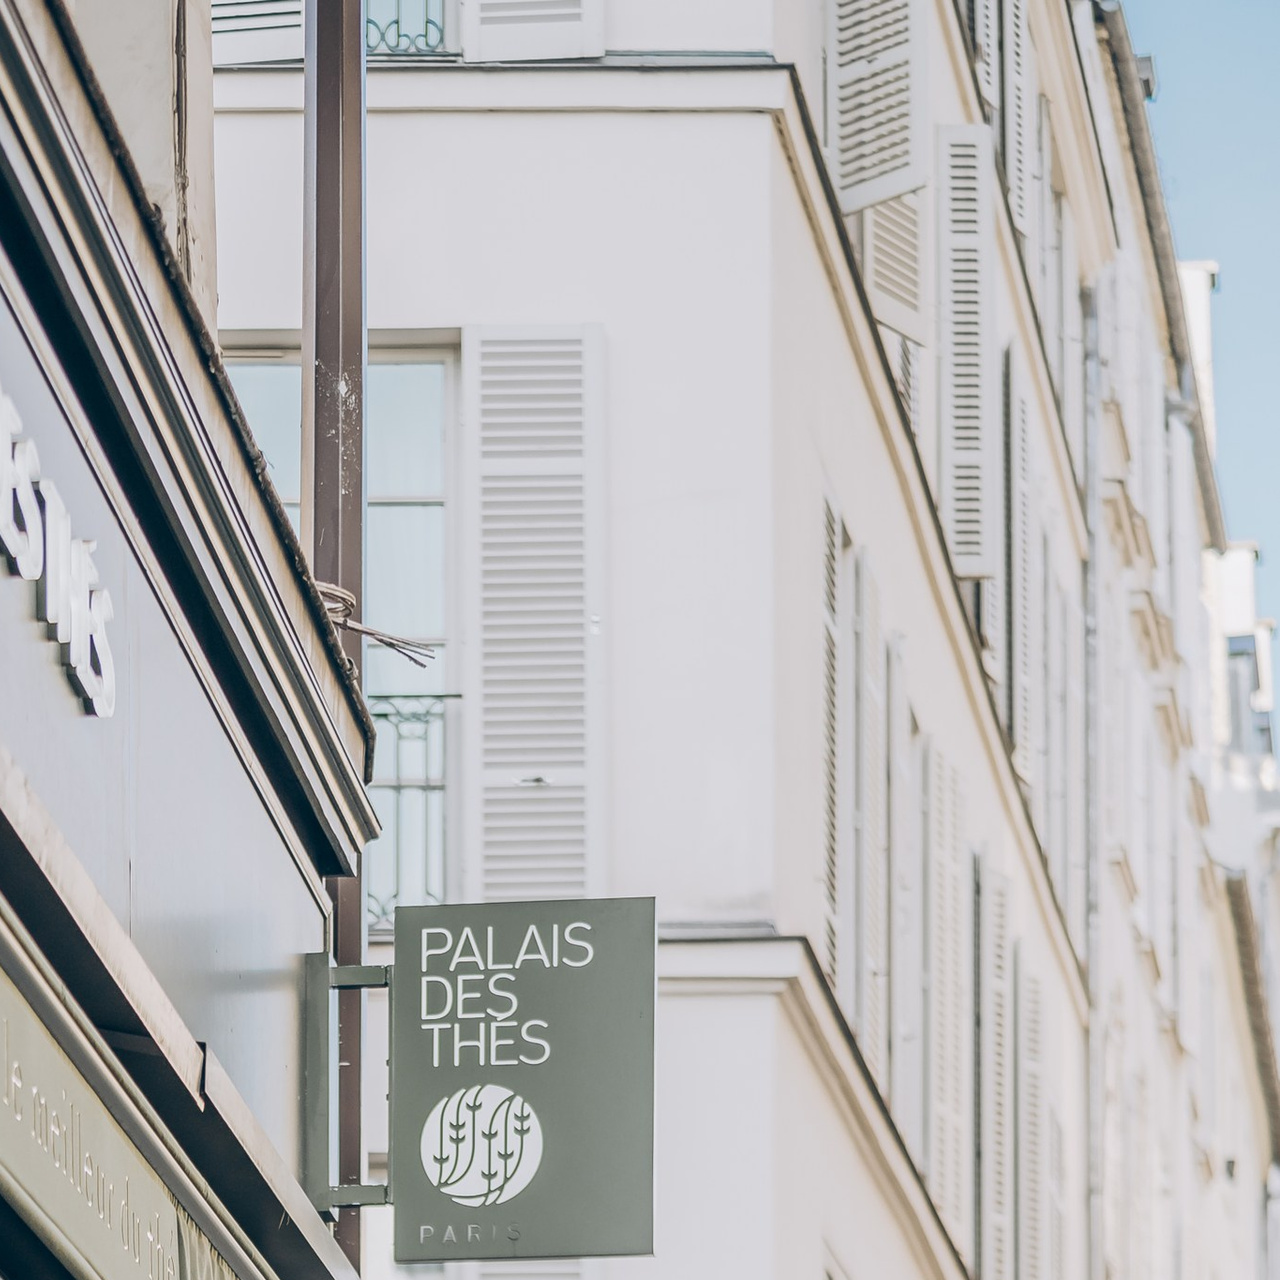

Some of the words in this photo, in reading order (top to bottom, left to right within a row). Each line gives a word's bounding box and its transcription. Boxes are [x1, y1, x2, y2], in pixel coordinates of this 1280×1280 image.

[421, 921, 595, 972] PALAIS
[421, 972, 519, 1019] DES
[421, 1013, 551, 1068] THÉS
[3, 1016, 24, 1123] le
[31, 1088, 115, 1230] meilleur
[120, 1174, 142, 1266] du
[420, 1222, 521, 1245] PARIS
